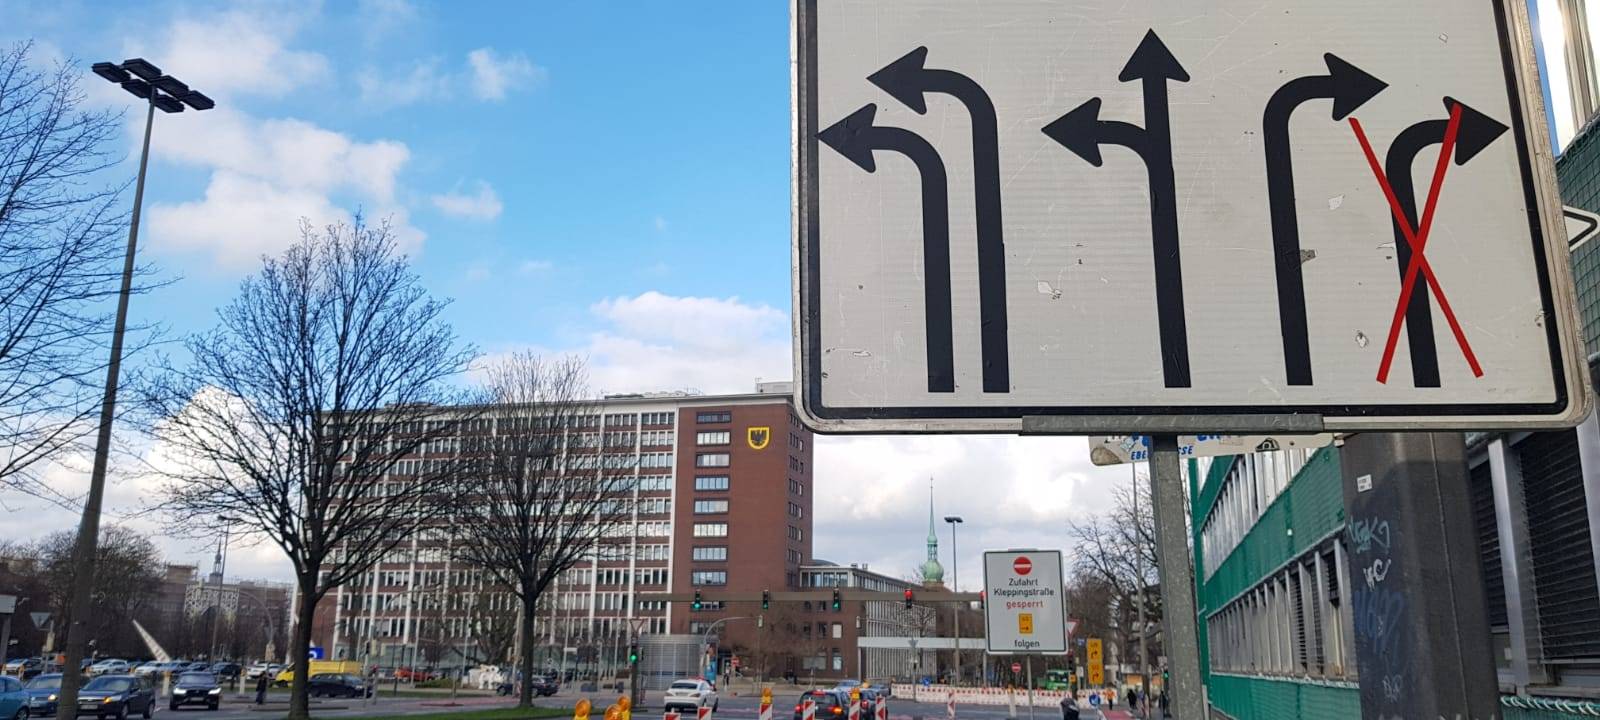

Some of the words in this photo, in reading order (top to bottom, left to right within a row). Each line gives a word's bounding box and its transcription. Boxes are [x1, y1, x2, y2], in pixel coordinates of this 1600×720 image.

[1008, 577, 1039, 586] Zufahrt
[993, 587, 1055, 598] Kleppingstraße
[1006, 600, 1044, 609] gesperrt
[1014, 639, 1041, 649] folgen
